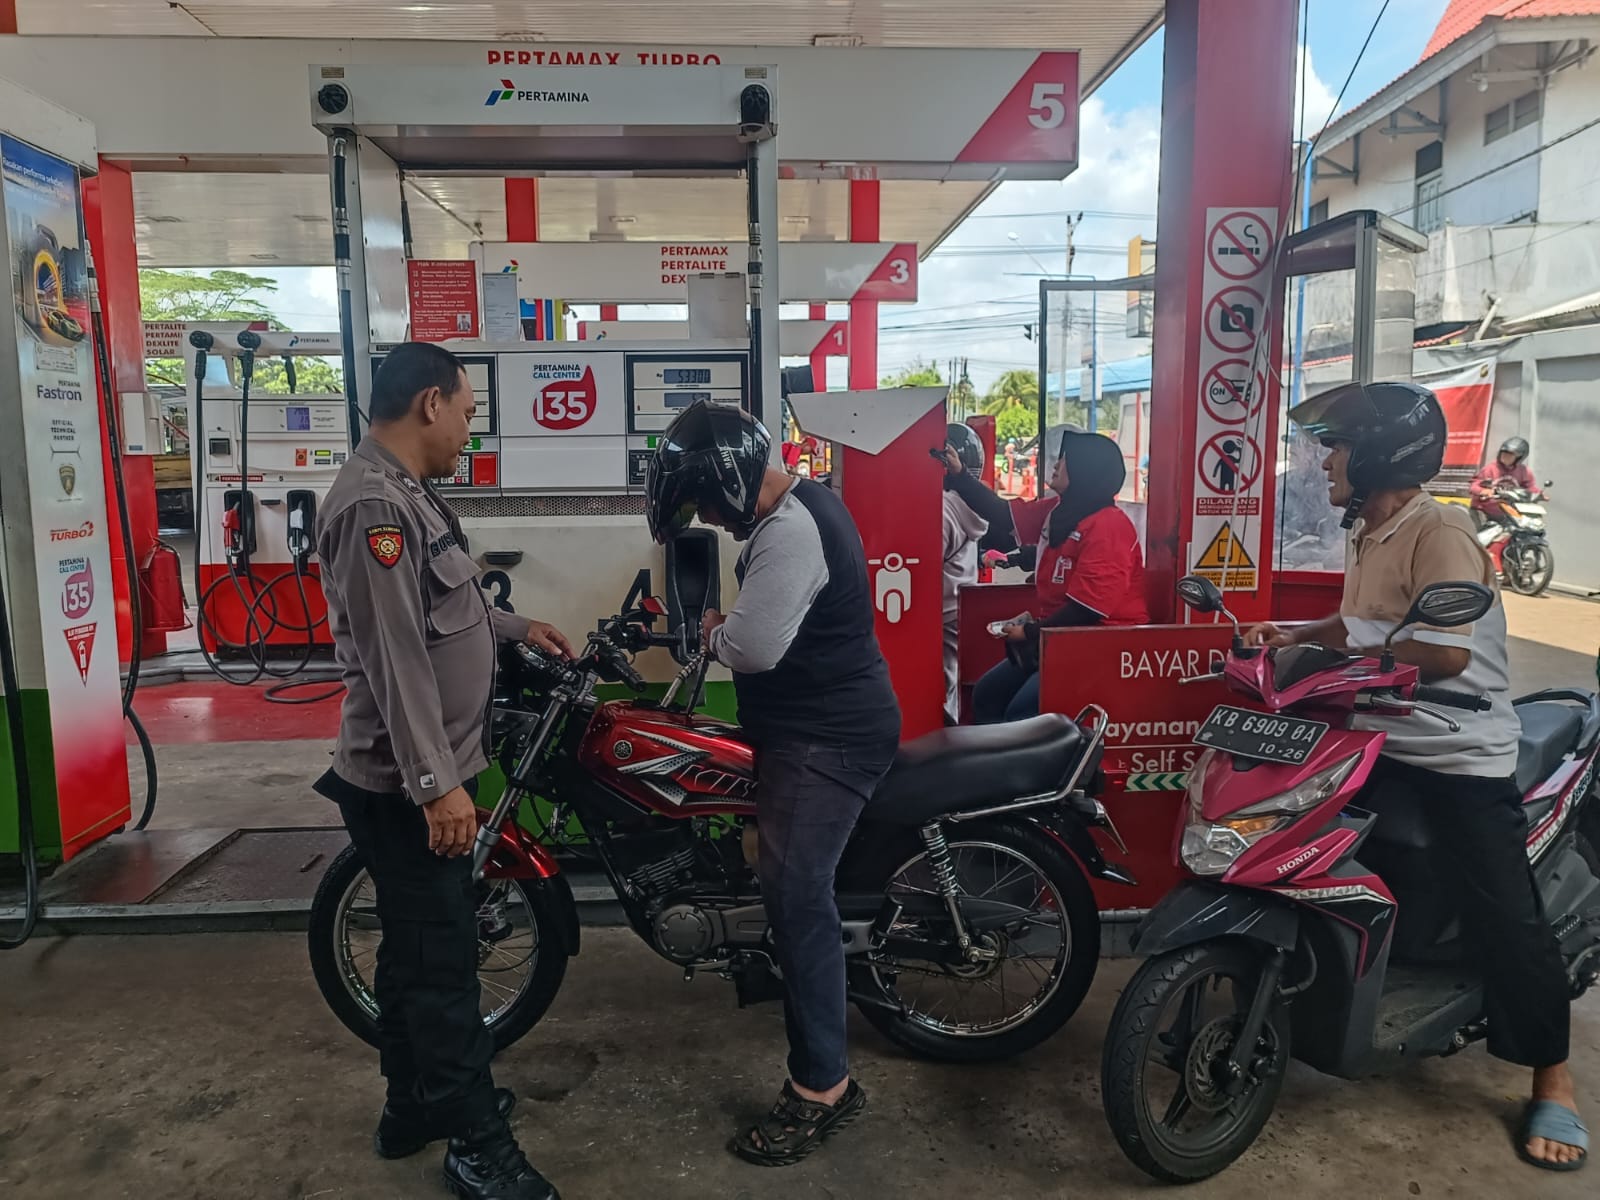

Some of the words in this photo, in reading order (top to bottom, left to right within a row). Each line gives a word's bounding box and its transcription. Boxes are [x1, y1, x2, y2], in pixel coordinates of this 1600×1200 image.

[517, 91, 590, 103] PERTAMINA
[1027, 83, 1066, 129] 5
[661, 246, 729, 256] PERTAMAX
[661, 260, 727, 270] PERTALITE
[889, 259, 909, 283] 3
[661, 274, 687, 284] DEX
[833, 330, 843, 346] 1
[533, 364, 581, 372] PERTAMINA
[553, 371, 581, 379] CENTER
[37, 384, 82, 401] Fastron
[1212, 387, 1226, 396] ON
[536, 391, 588, 421] 135
[50, 529, 87, 542] TURBO
[59, 557, 85, 567] PERTAMINA
[63, 581, 91, 613] 135
[1120, 649, 1200, 678] BAYAR
[1210, 708, 1240, 727] KB
[1241, 715, 1289, 737] 6909
[1131, 750, 1176, 773] Self
[1276, 847, 1320, 874] HONDA
